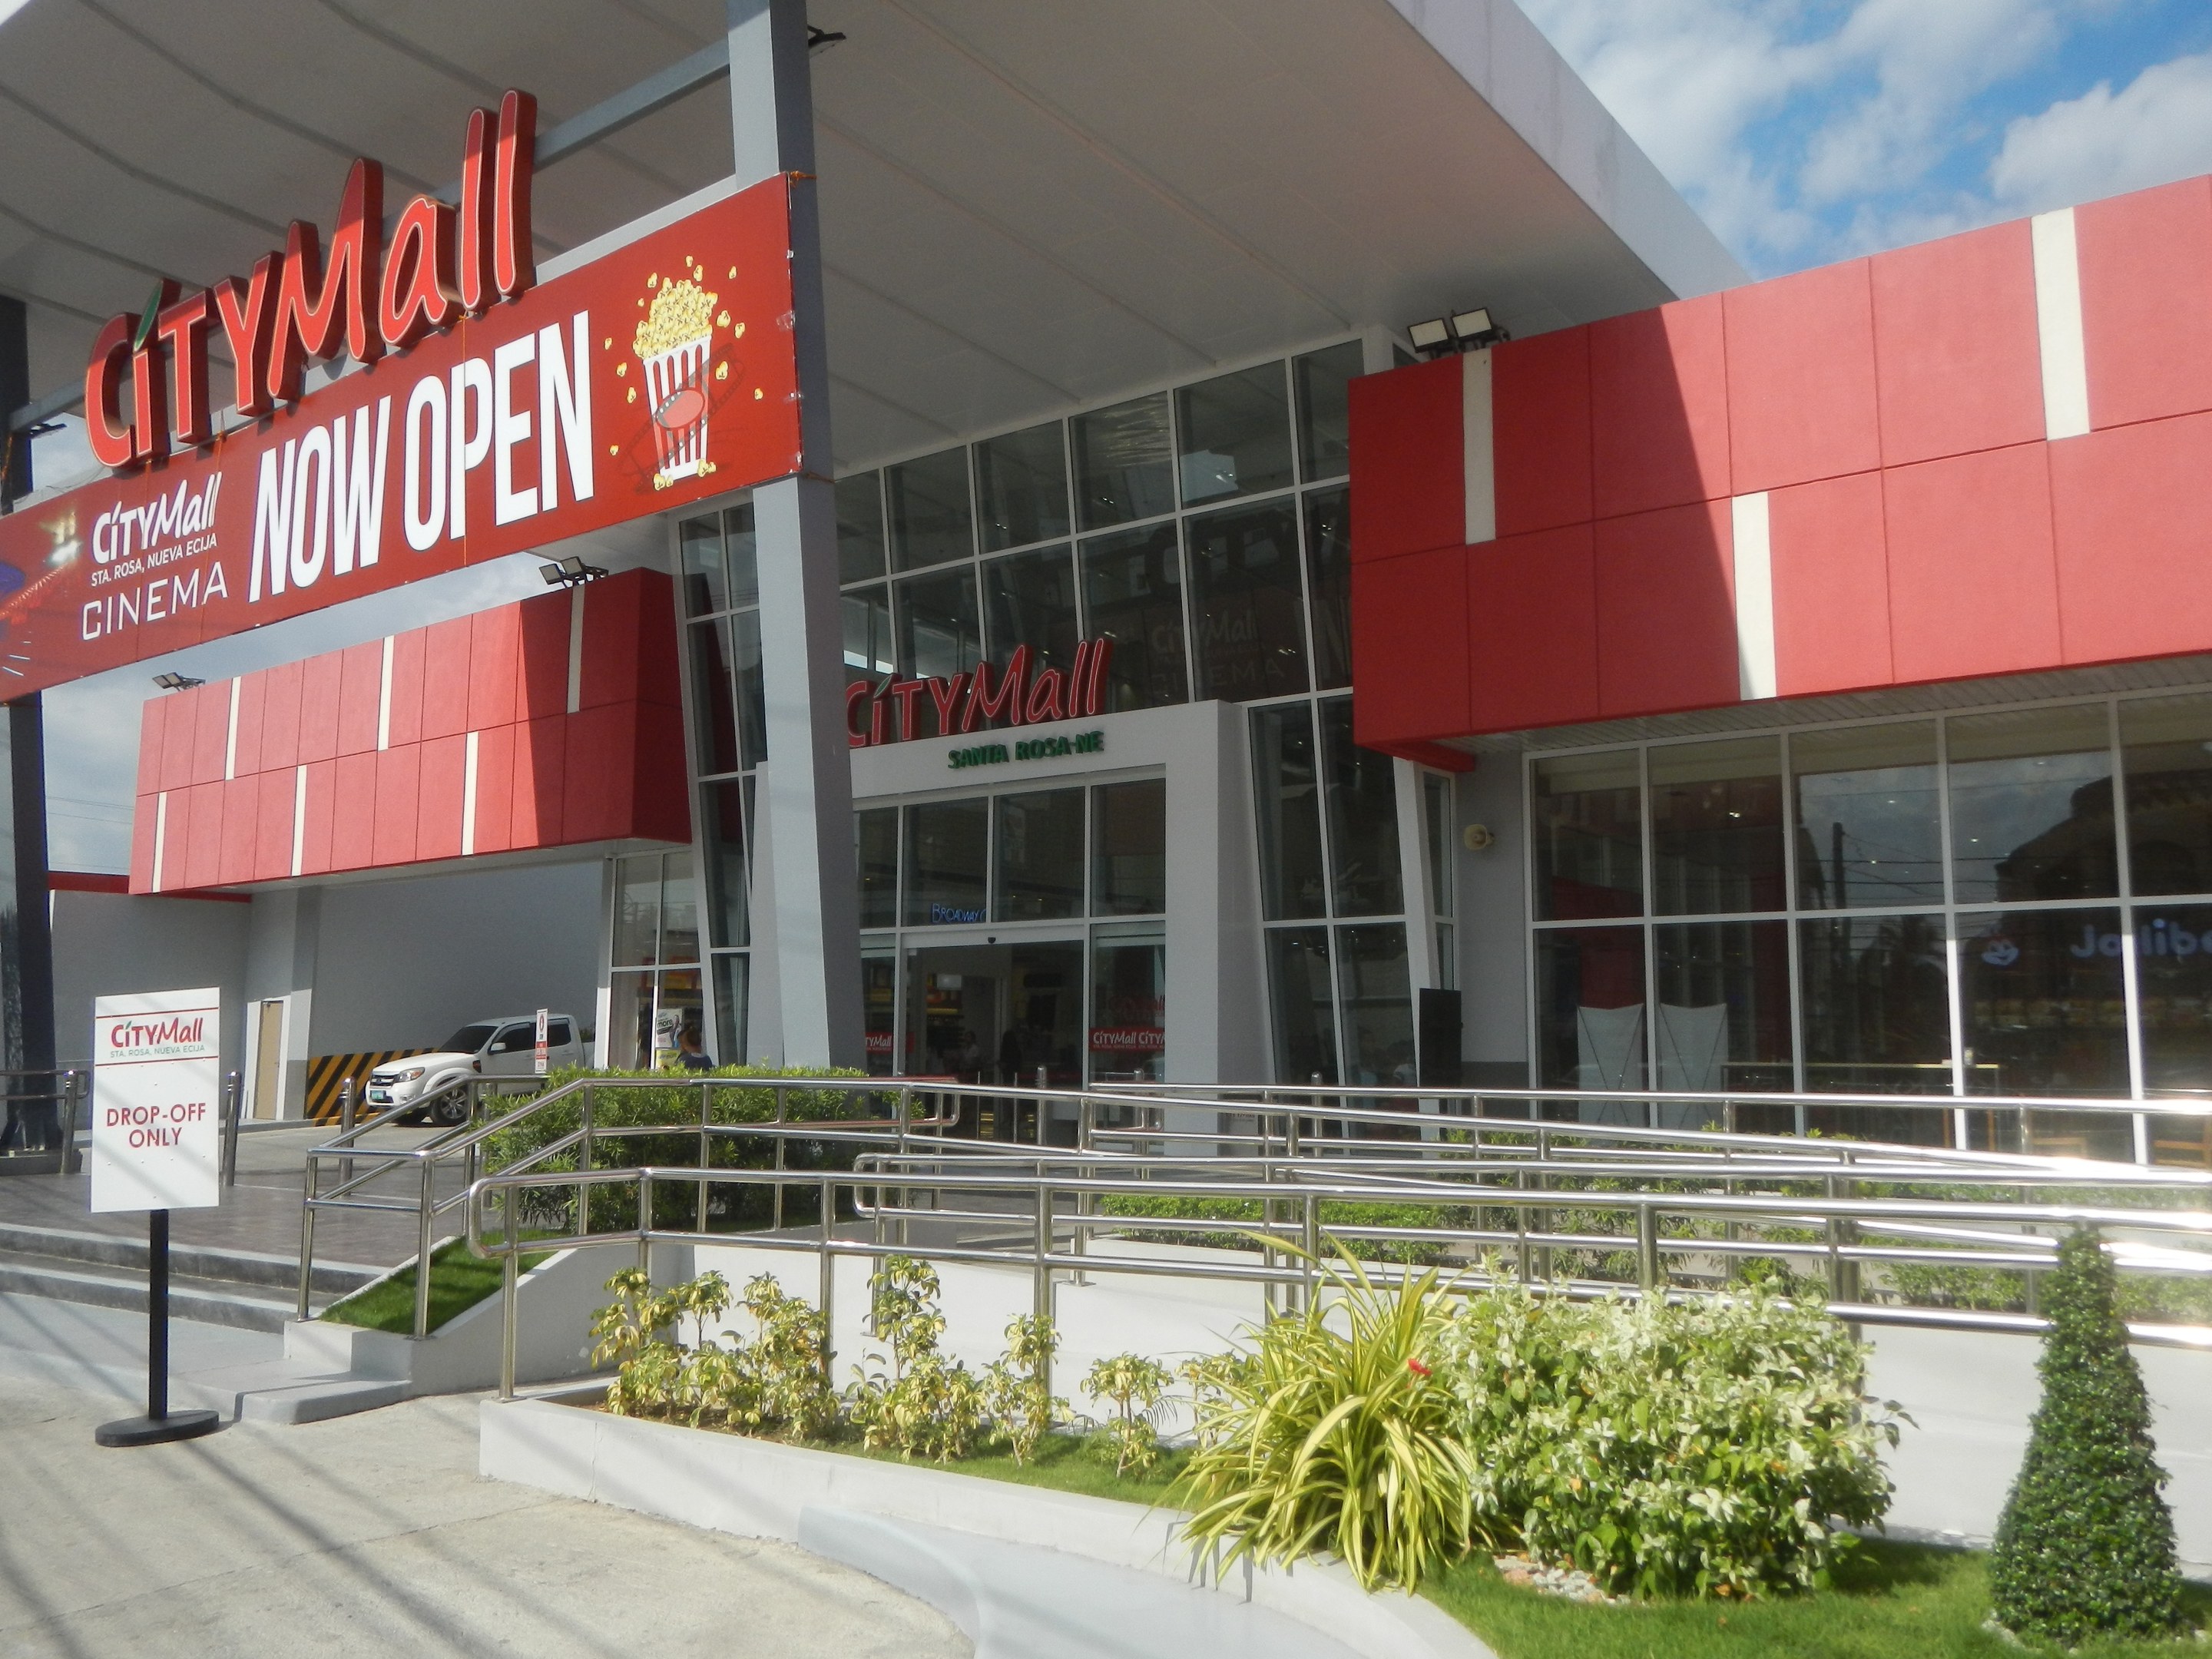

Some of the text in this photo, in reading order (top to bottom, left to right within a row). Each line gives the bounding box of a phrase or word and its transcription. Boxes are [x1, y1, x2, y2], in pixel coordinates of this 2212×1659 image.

[249, 310, 594, 603] NOW OPEN
[91, 533, 217, 587] STA. ROSA, NUEVA ECIJA
[82, 561, 228, 641] CINEMA
[948, 743, 1010, 769] SANTA
[2070, 918, 2212, 958] Jolib
[657, 1018, 673, 1028] more
[154, 1046, 180, 1055] NUEVA
[183, 1045, 205, 1053] ECIJA
[106, 1103, 207, 1127] DROP-OFF
[128, 1128, 183, 1148] ONLY
